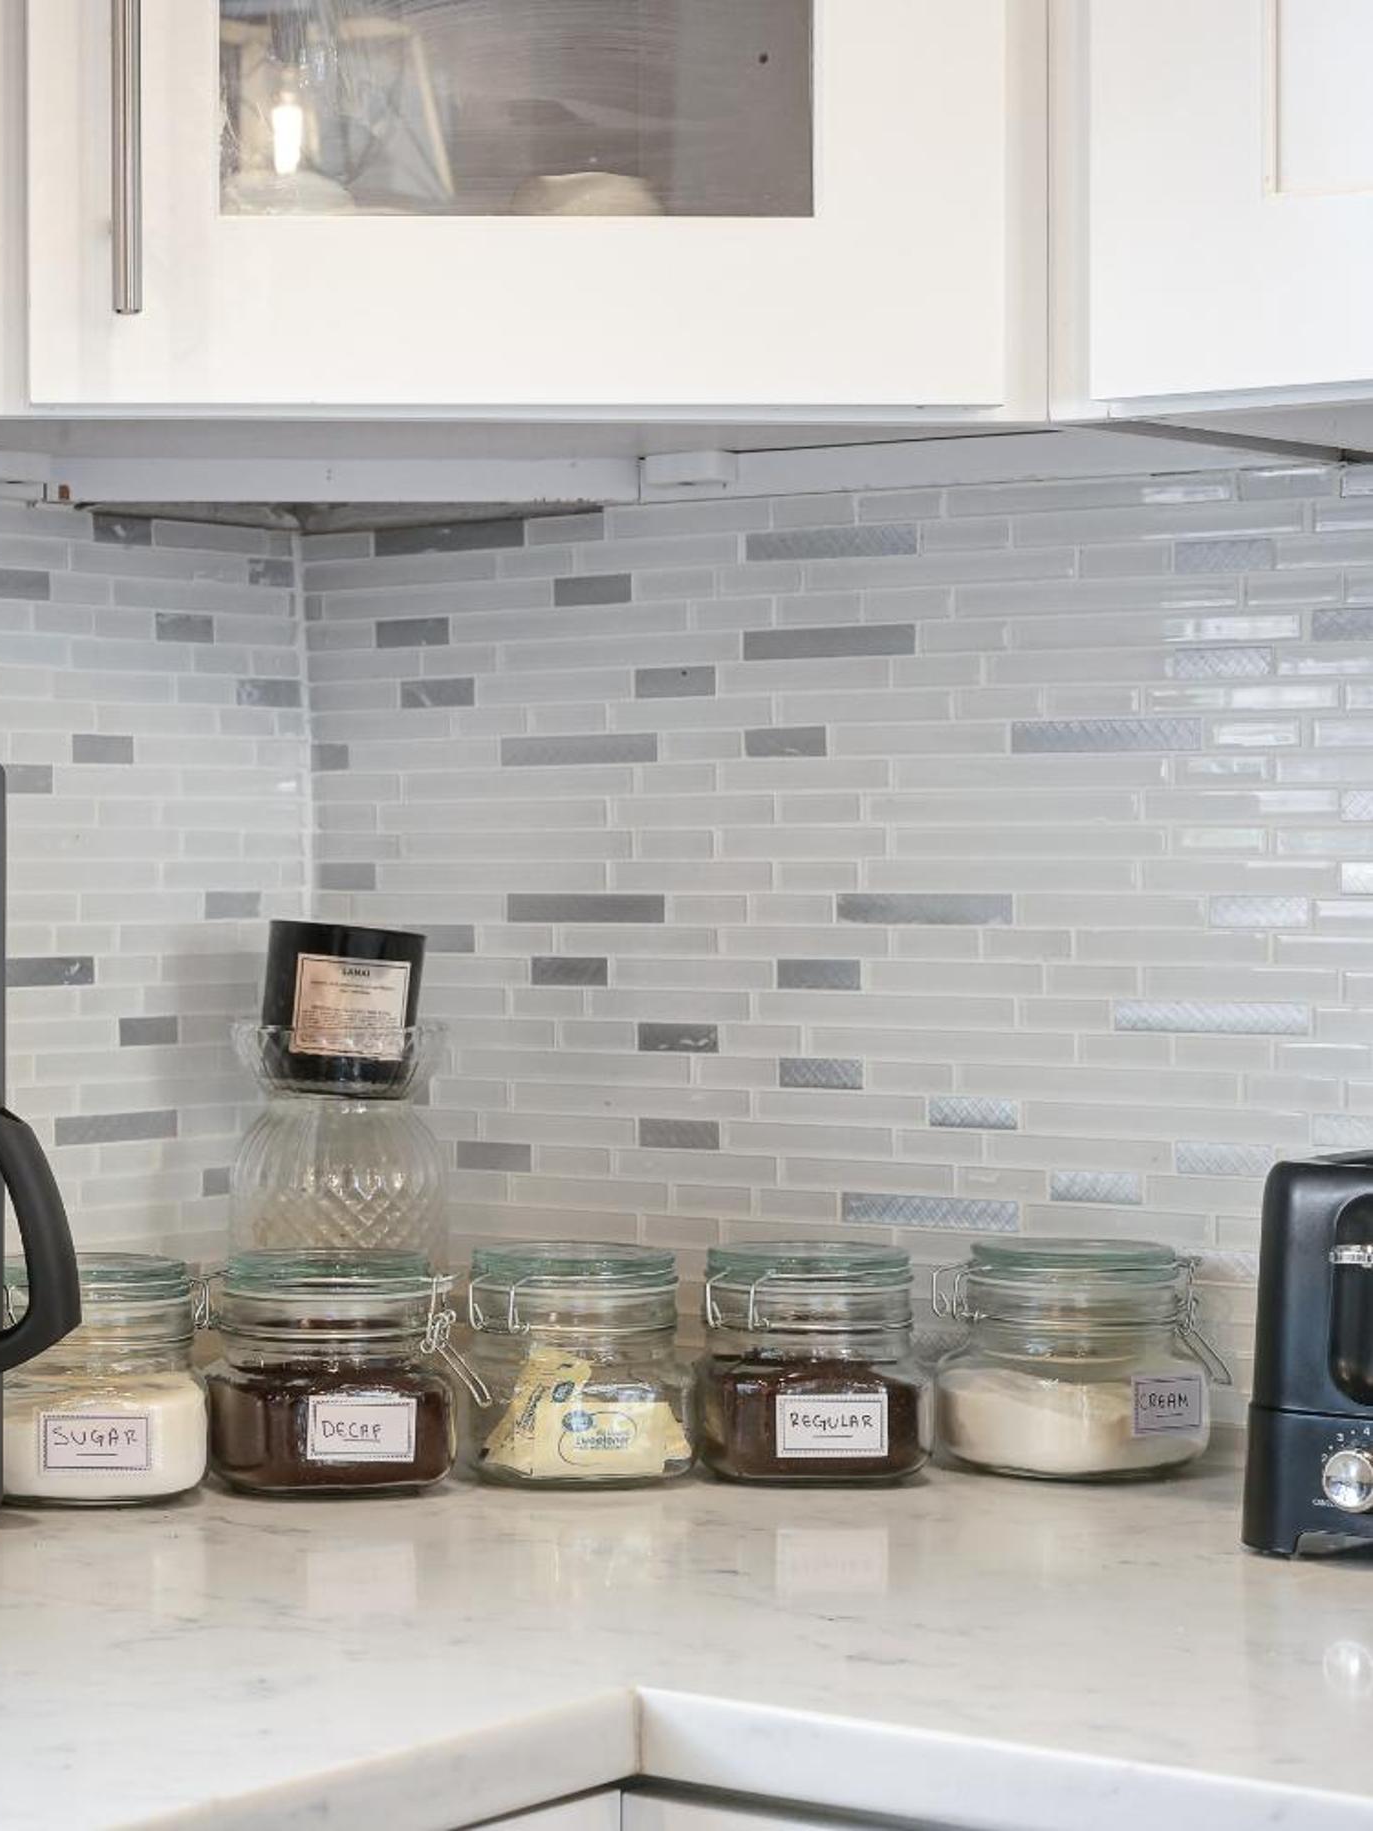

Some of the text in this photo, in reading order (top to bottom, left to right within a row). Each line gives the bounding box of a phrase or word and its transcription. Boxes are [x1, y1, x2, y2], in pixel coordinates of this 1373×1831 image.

[1139, 1392, 1189, 1411] CREAM
[320, 1419, 383, 1439] DECAF
[788, 1412, 878, 1430] REGULAR
[52, 1426, 139, 1447] SUGAR
